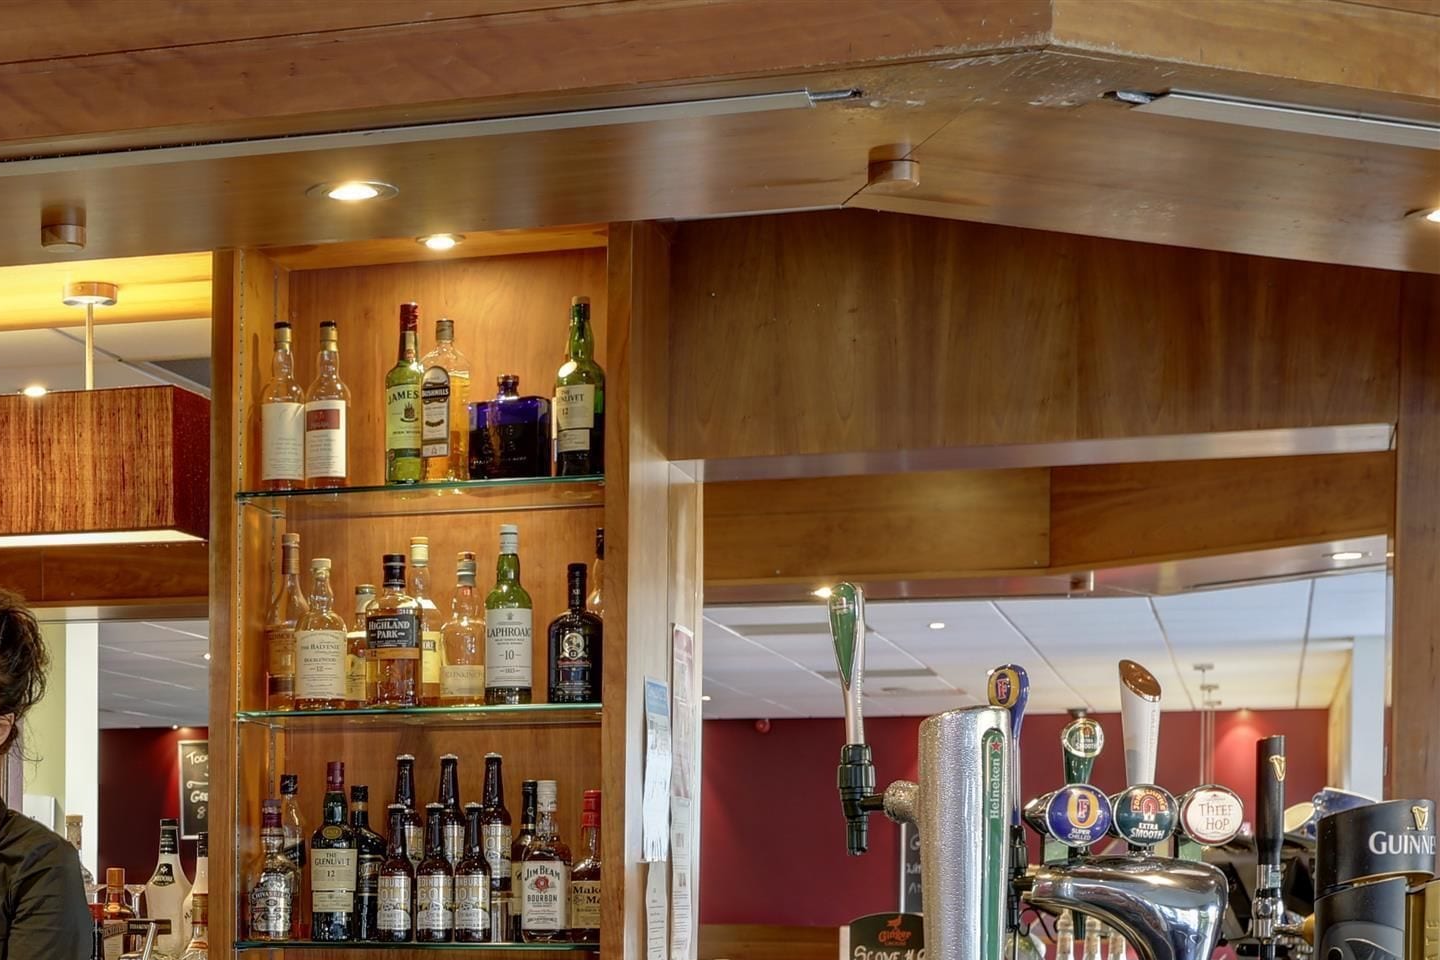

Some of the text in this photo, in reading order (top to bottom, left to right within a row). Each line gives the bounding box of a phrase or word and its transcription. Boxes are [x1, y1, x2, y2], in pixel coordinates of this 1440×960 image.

[368, 620, 410, 630] HIGHLAND
[376, 630, 399, 639] PARK
[504, 650, 515, 660] 10
[989, 757, 1002, 820] Heineken
[1138, 822, 1159, 831] EXTRA
[1206, 818, 1230, 831] HOP
[1129, 829, 1165, 840] SMOOTH
[525, 864, 560, 881] JIM BEAM
[527, 894, 558, 902] BOURBON
